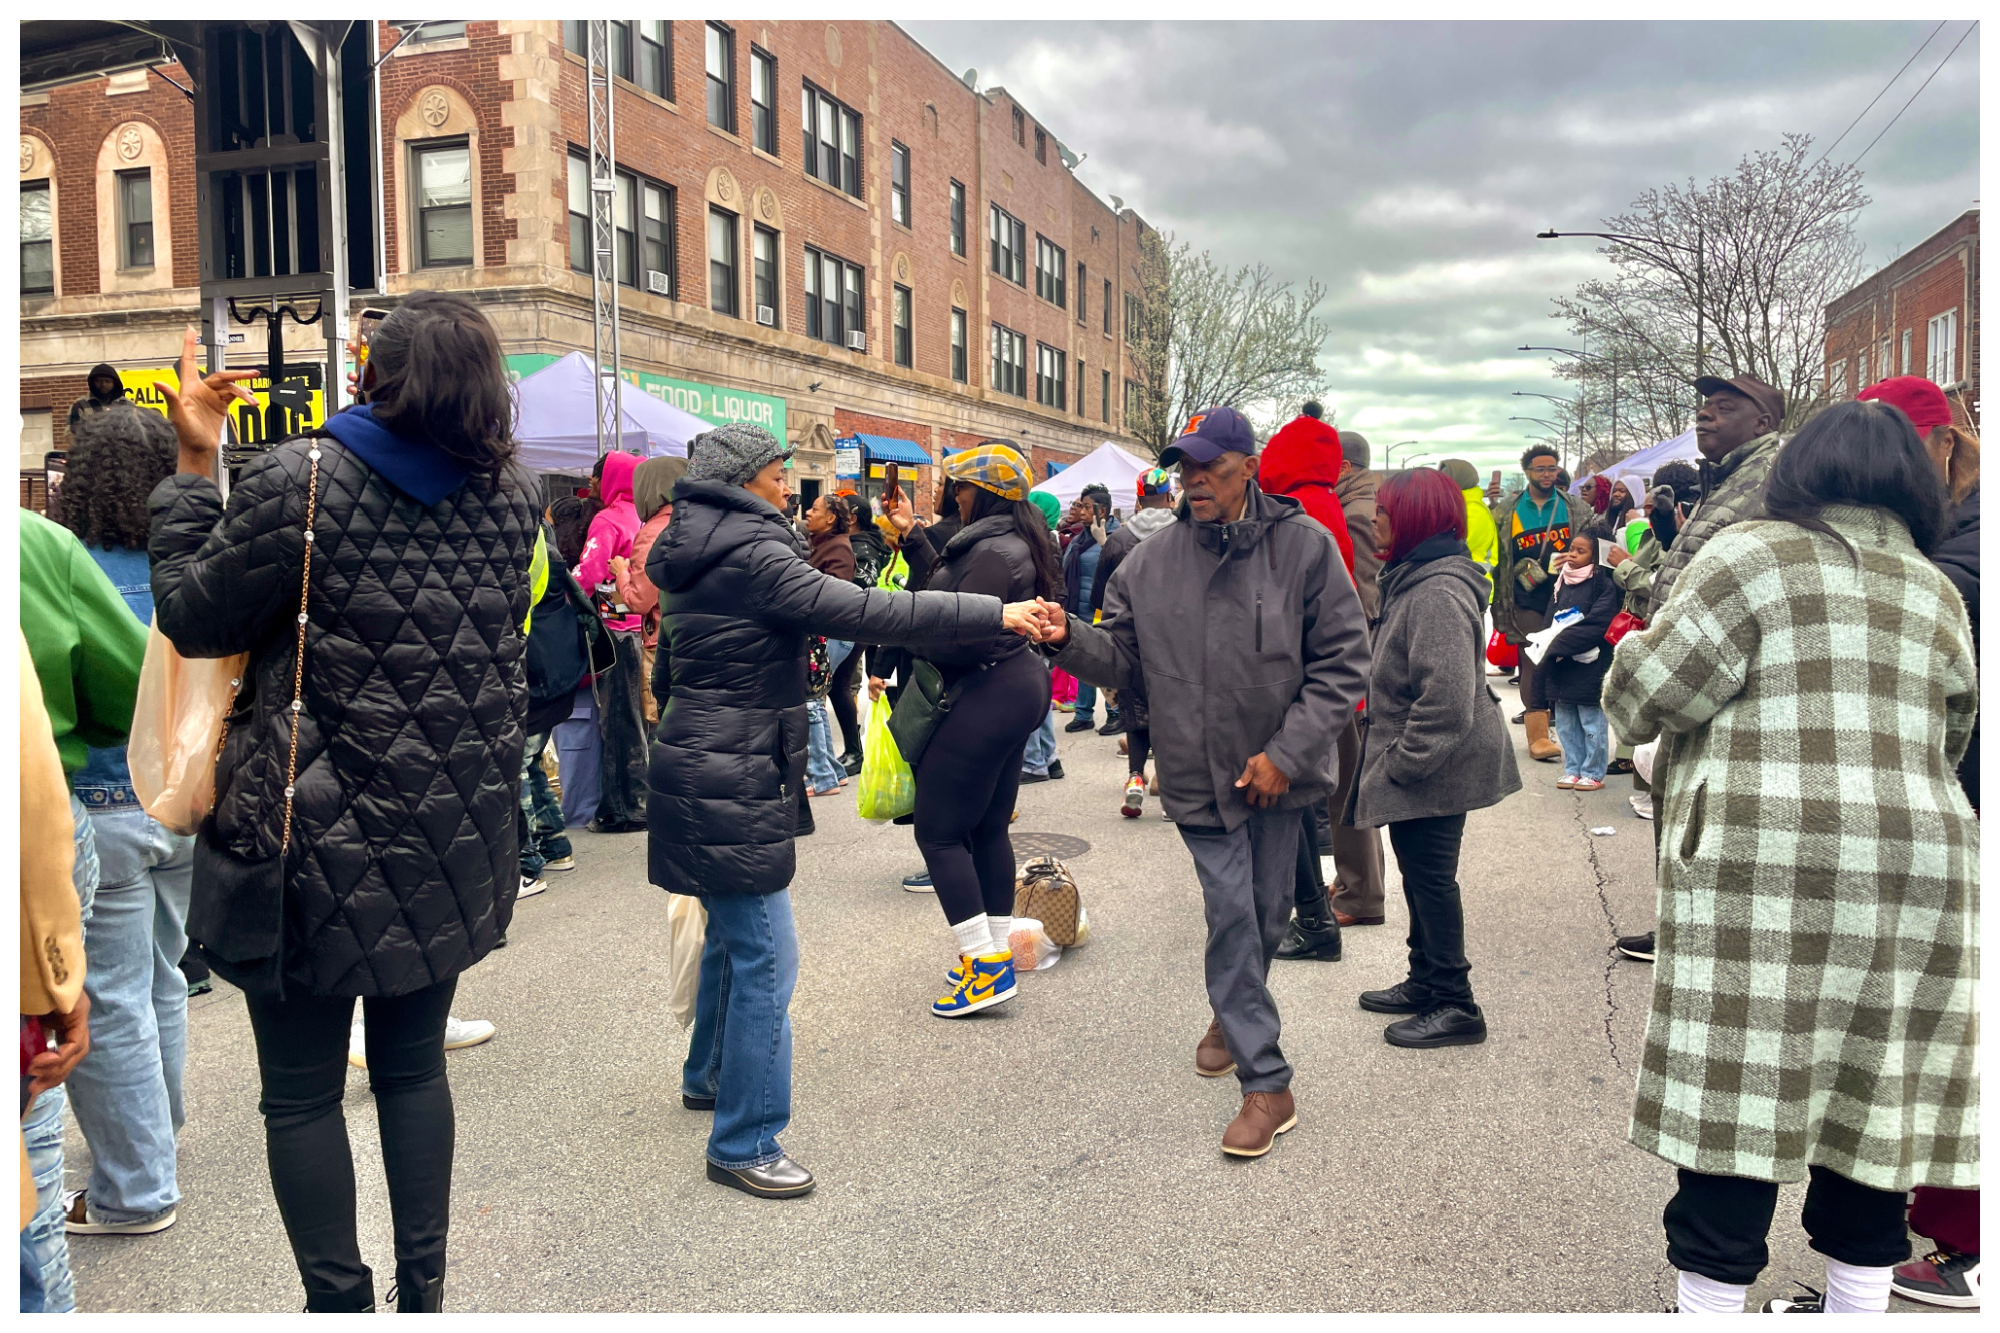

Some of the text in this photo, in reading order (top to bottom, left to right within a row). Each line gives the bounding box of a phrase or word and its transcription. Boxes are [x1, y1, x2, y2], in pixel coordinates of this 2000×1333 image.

[123, 387, 164, 405] CALL
[645, 382, 774, 428] FOOD LIQUOR
[1181, 414, 1207, 437] I
